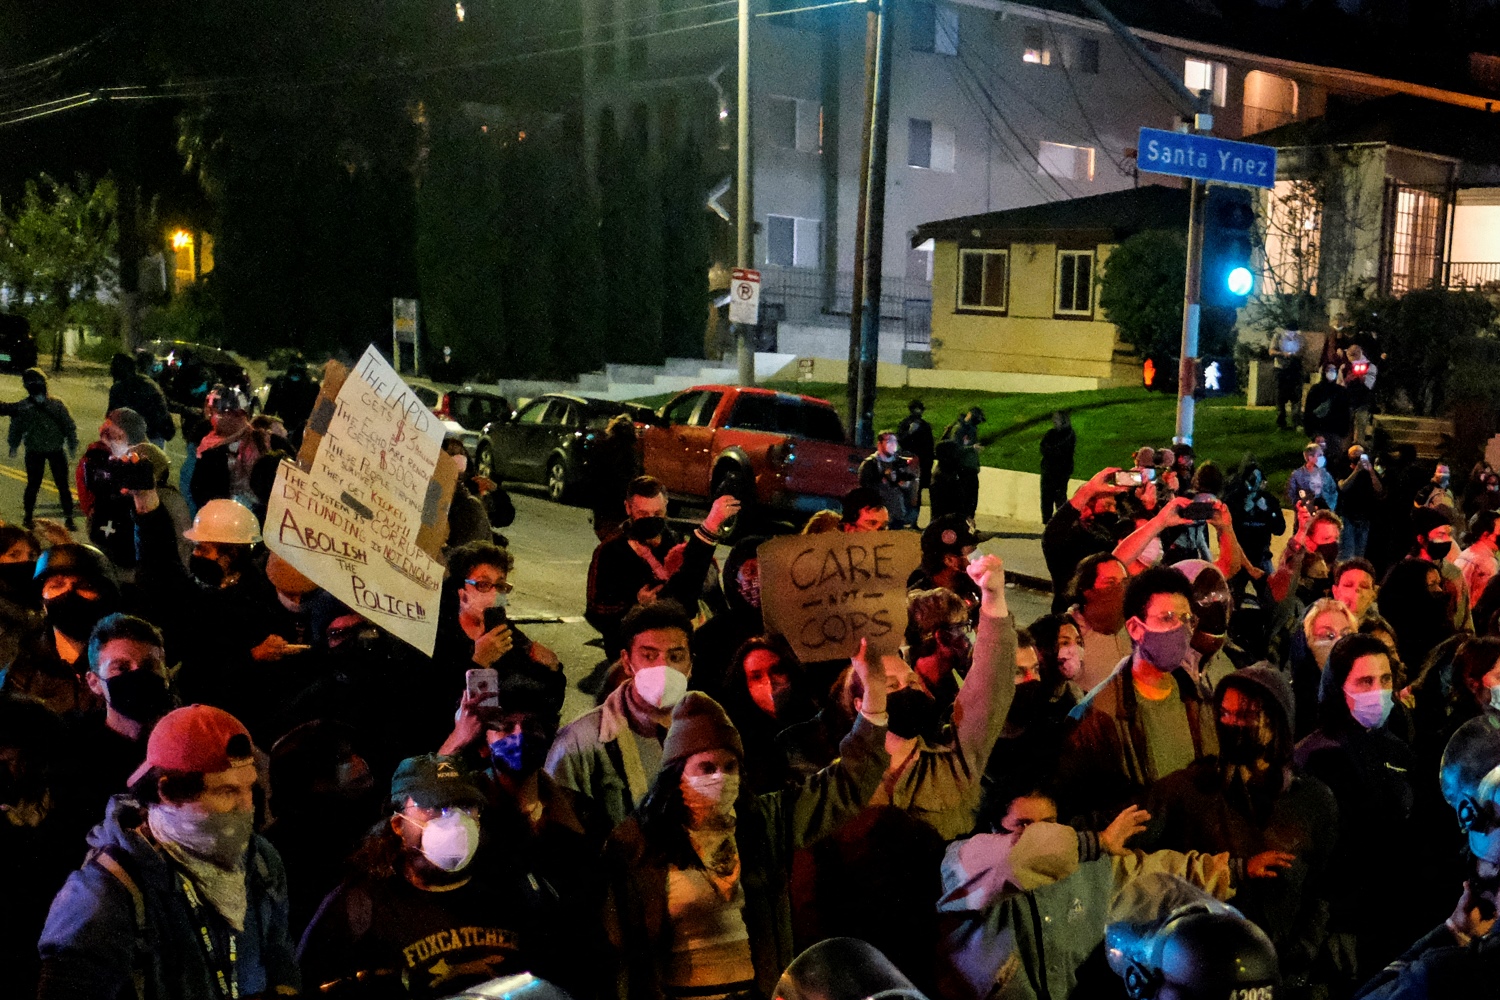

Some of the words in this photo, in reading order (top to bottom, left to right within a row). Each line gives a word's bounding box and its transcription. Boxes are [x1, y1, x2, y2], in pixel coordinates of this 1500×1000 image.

[1148, 139, 1207, 168] Santa
[1218, 149, 1268, 177] Ynez
[360, 352, 387, 398] THE
[384, 382, 429, 432] LAPD
[279, 508, 368, 563] ABOLISH
[281, 462, 306, 489] THE
[370, 519, 436, 571] CORRUPT
[283, 484, 367, 543] DEFUNDING
[335, 558, 357, 575] THE
[790, 543, 895, 590] CARE
[800, 610, 892, 649] COPS
